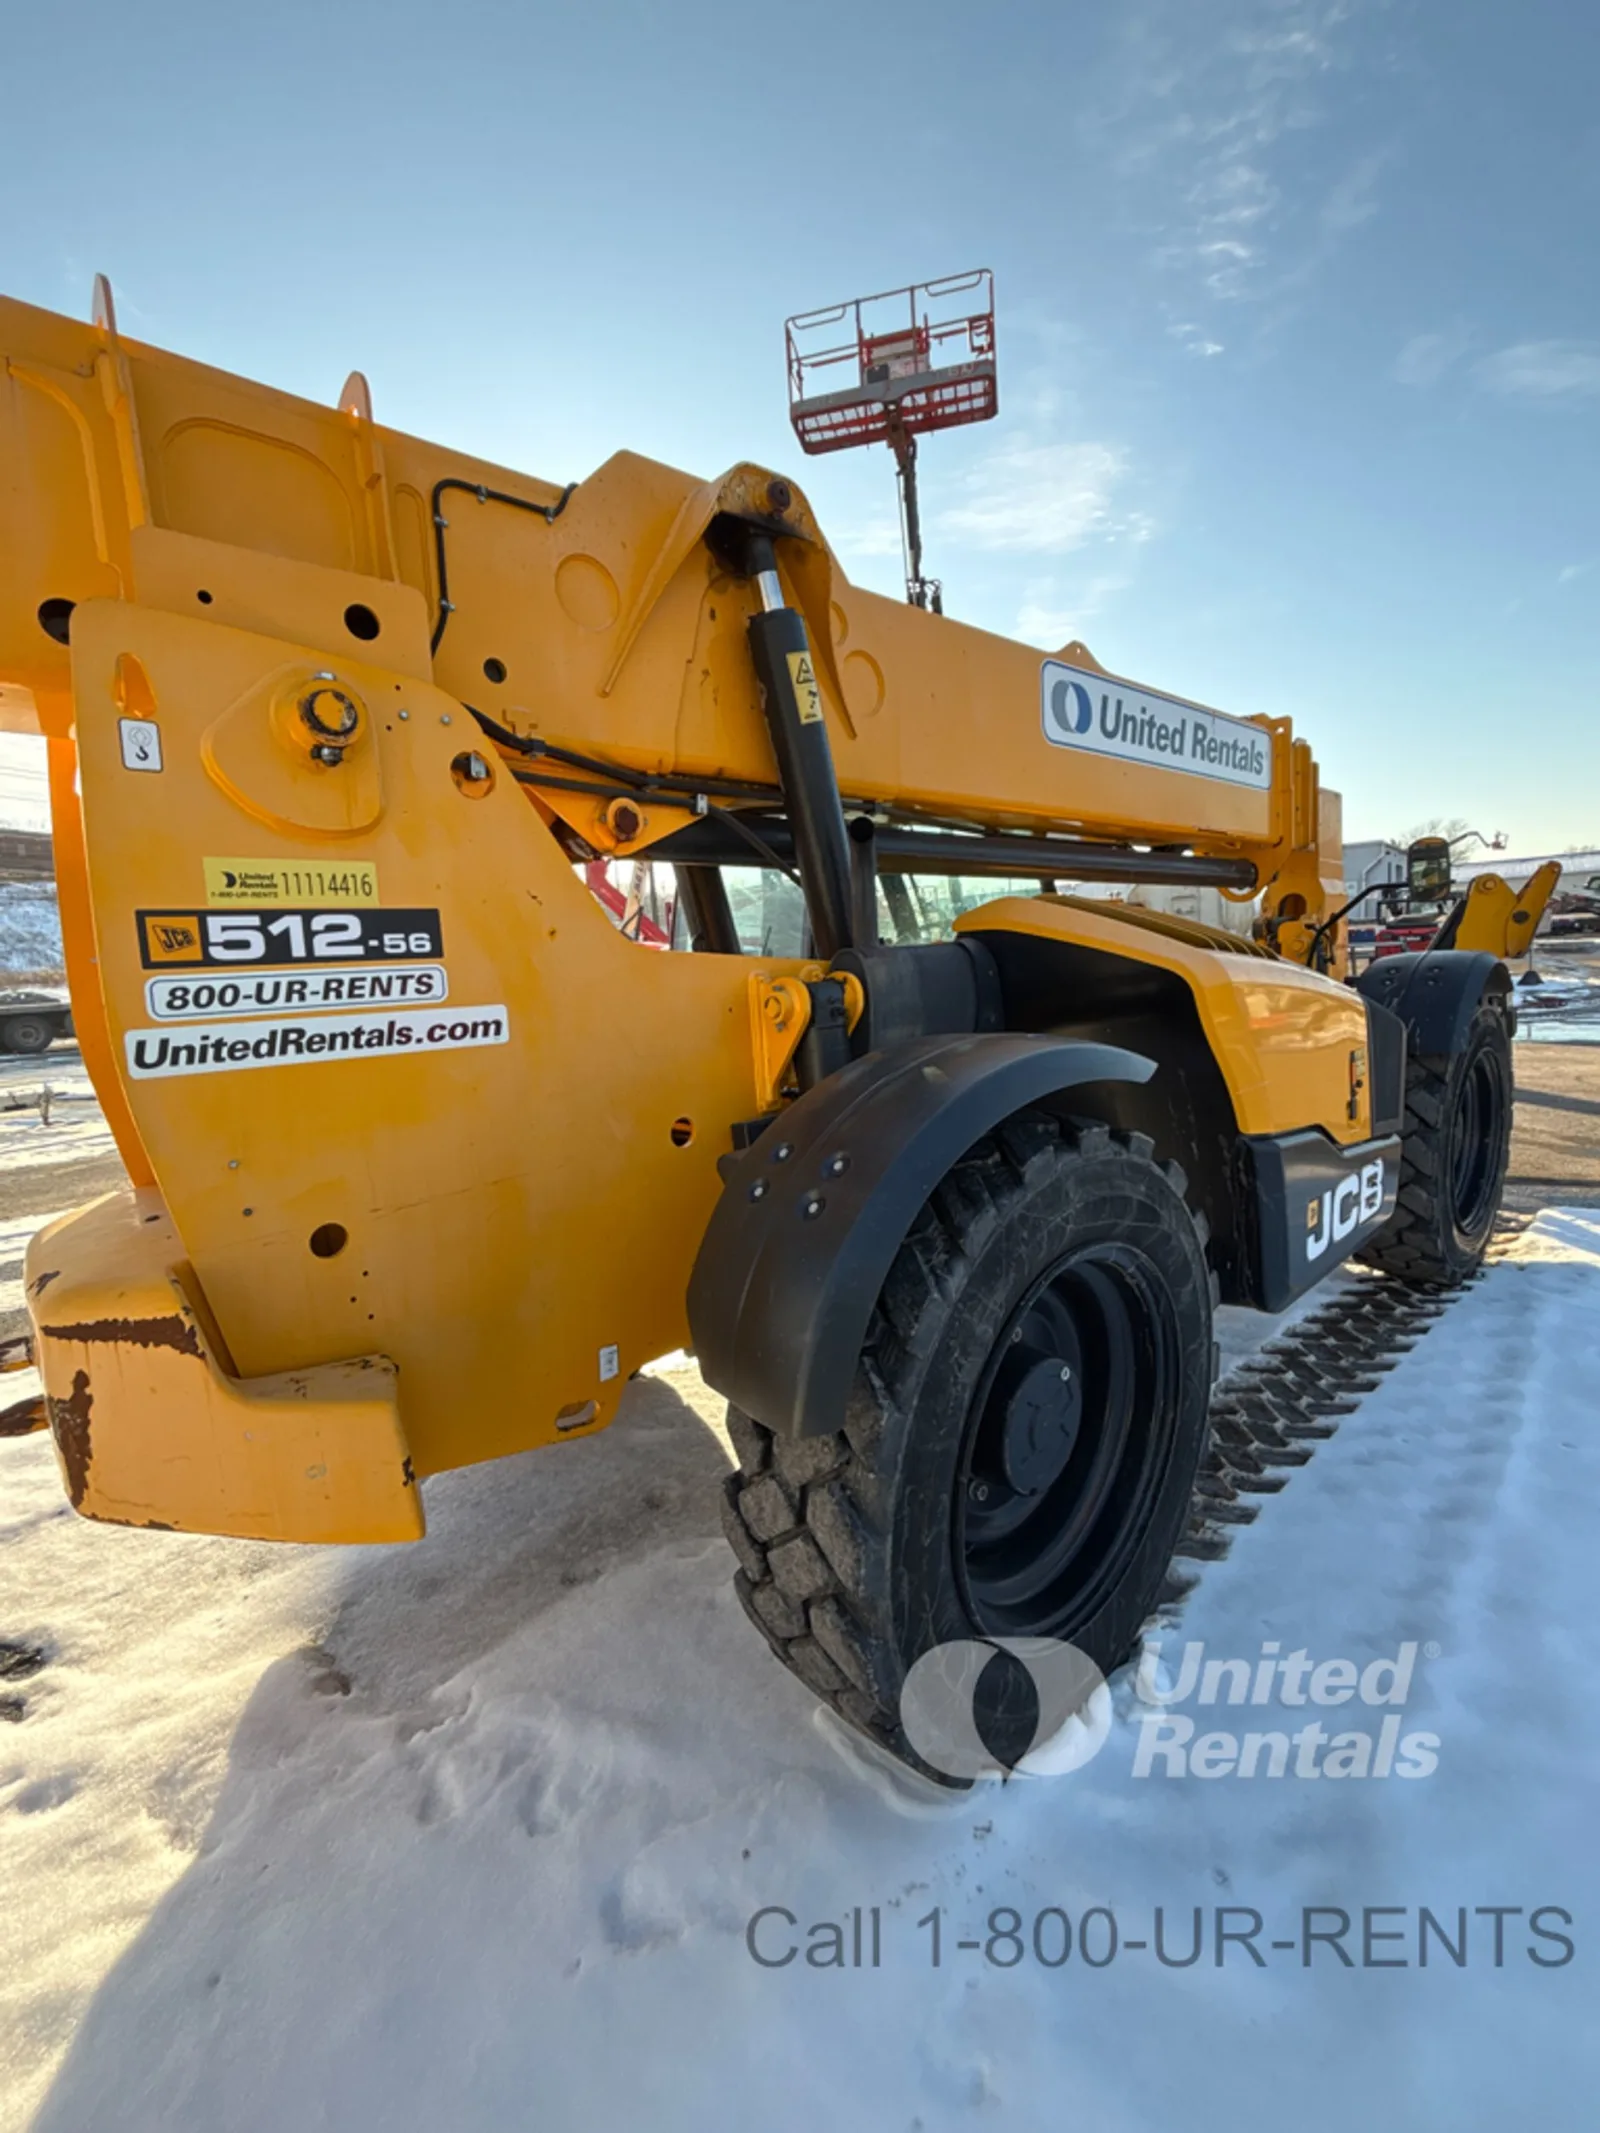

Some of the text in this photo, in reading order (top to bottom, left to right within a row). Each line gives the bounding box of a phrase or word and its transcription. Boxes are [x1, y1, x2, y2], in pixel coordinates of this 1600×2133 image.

[1100, 693, 1264, 775] United Rentals
[281, 872, 373, 897] 11114416
[156, 925, 196, 952] JCB
[206, 914, 432, 960] 512-56
[166, 972, 435, 1012] 800-UR-RENTS
[133, 1017, 502, 1070] UnitedRentals.com
[1306, 1157, 1384, 1262] JCB
